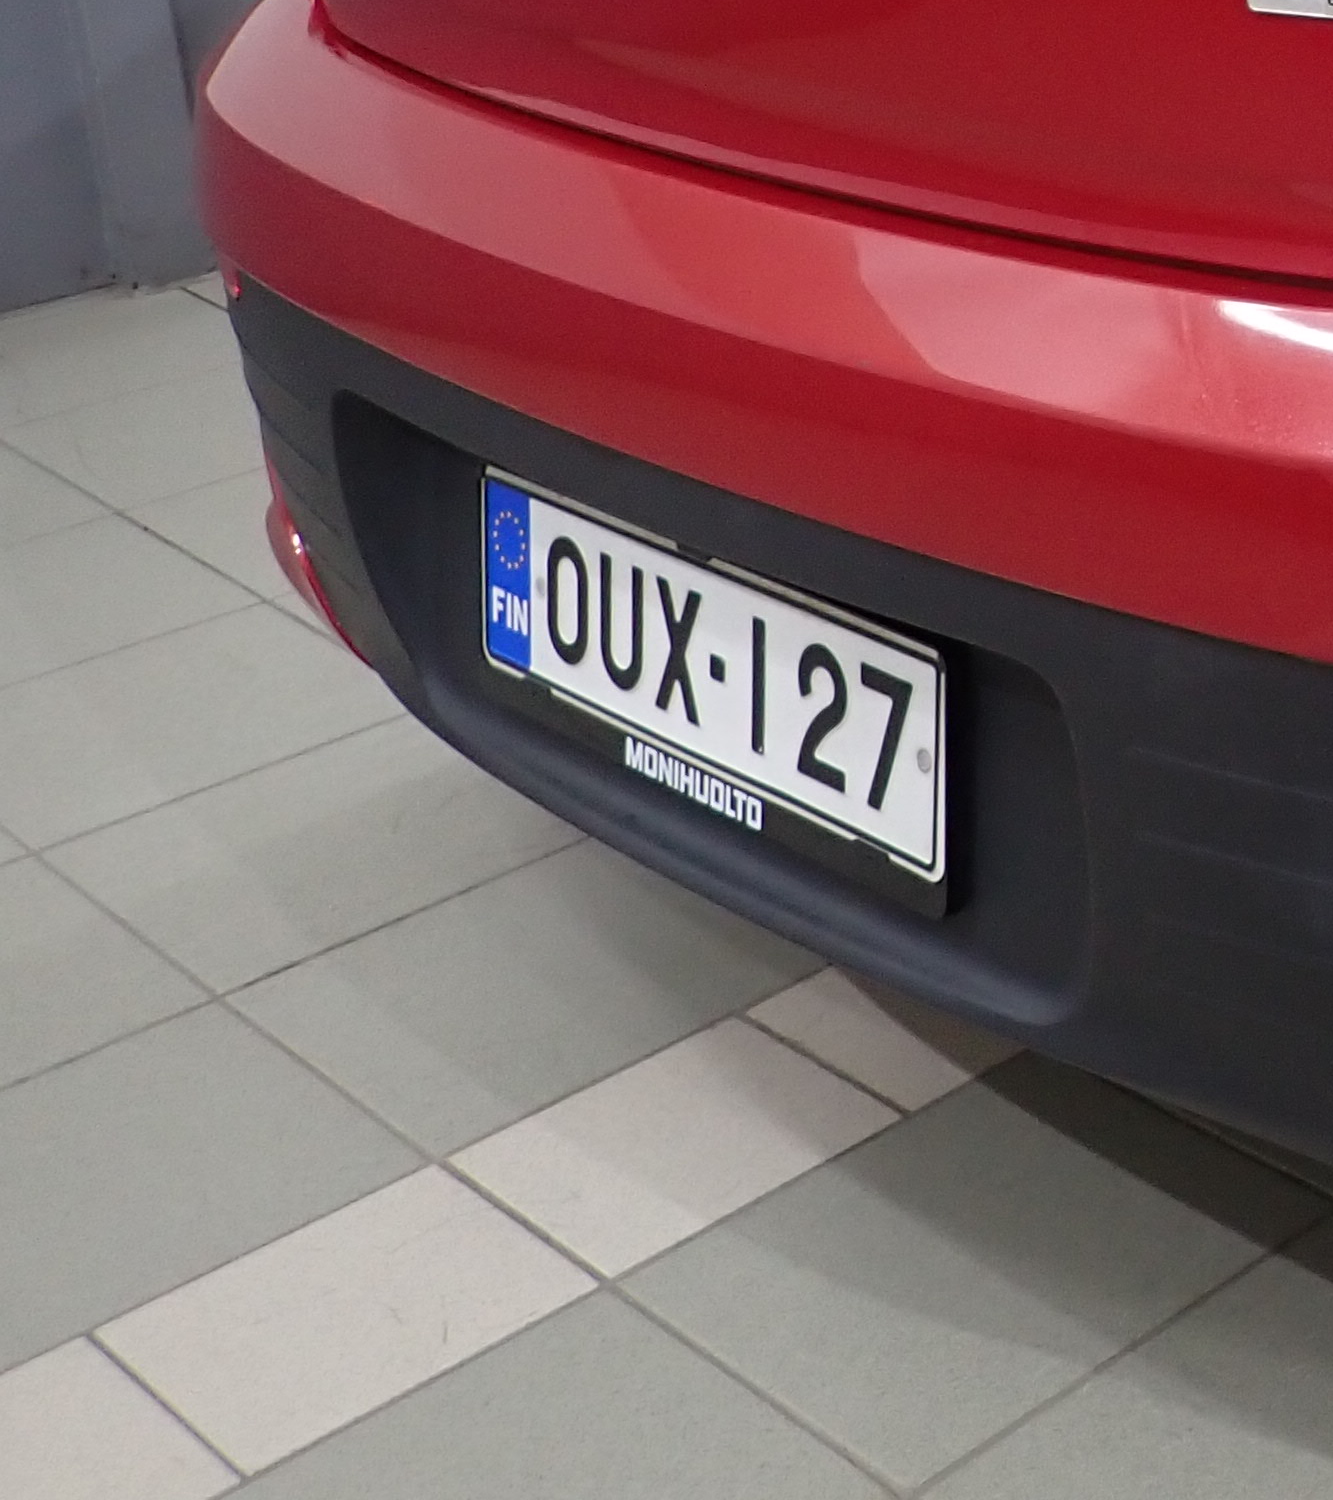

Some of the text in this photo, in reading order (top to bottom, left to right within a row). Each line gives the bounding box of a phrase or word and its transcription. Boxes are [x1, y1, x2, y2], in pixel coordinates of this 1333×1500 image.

[492, 585, 528, 636] FIN
[546, 535, 914, 811] OUX-127
[624, 735, 763, 831] MONIHUOLTO
